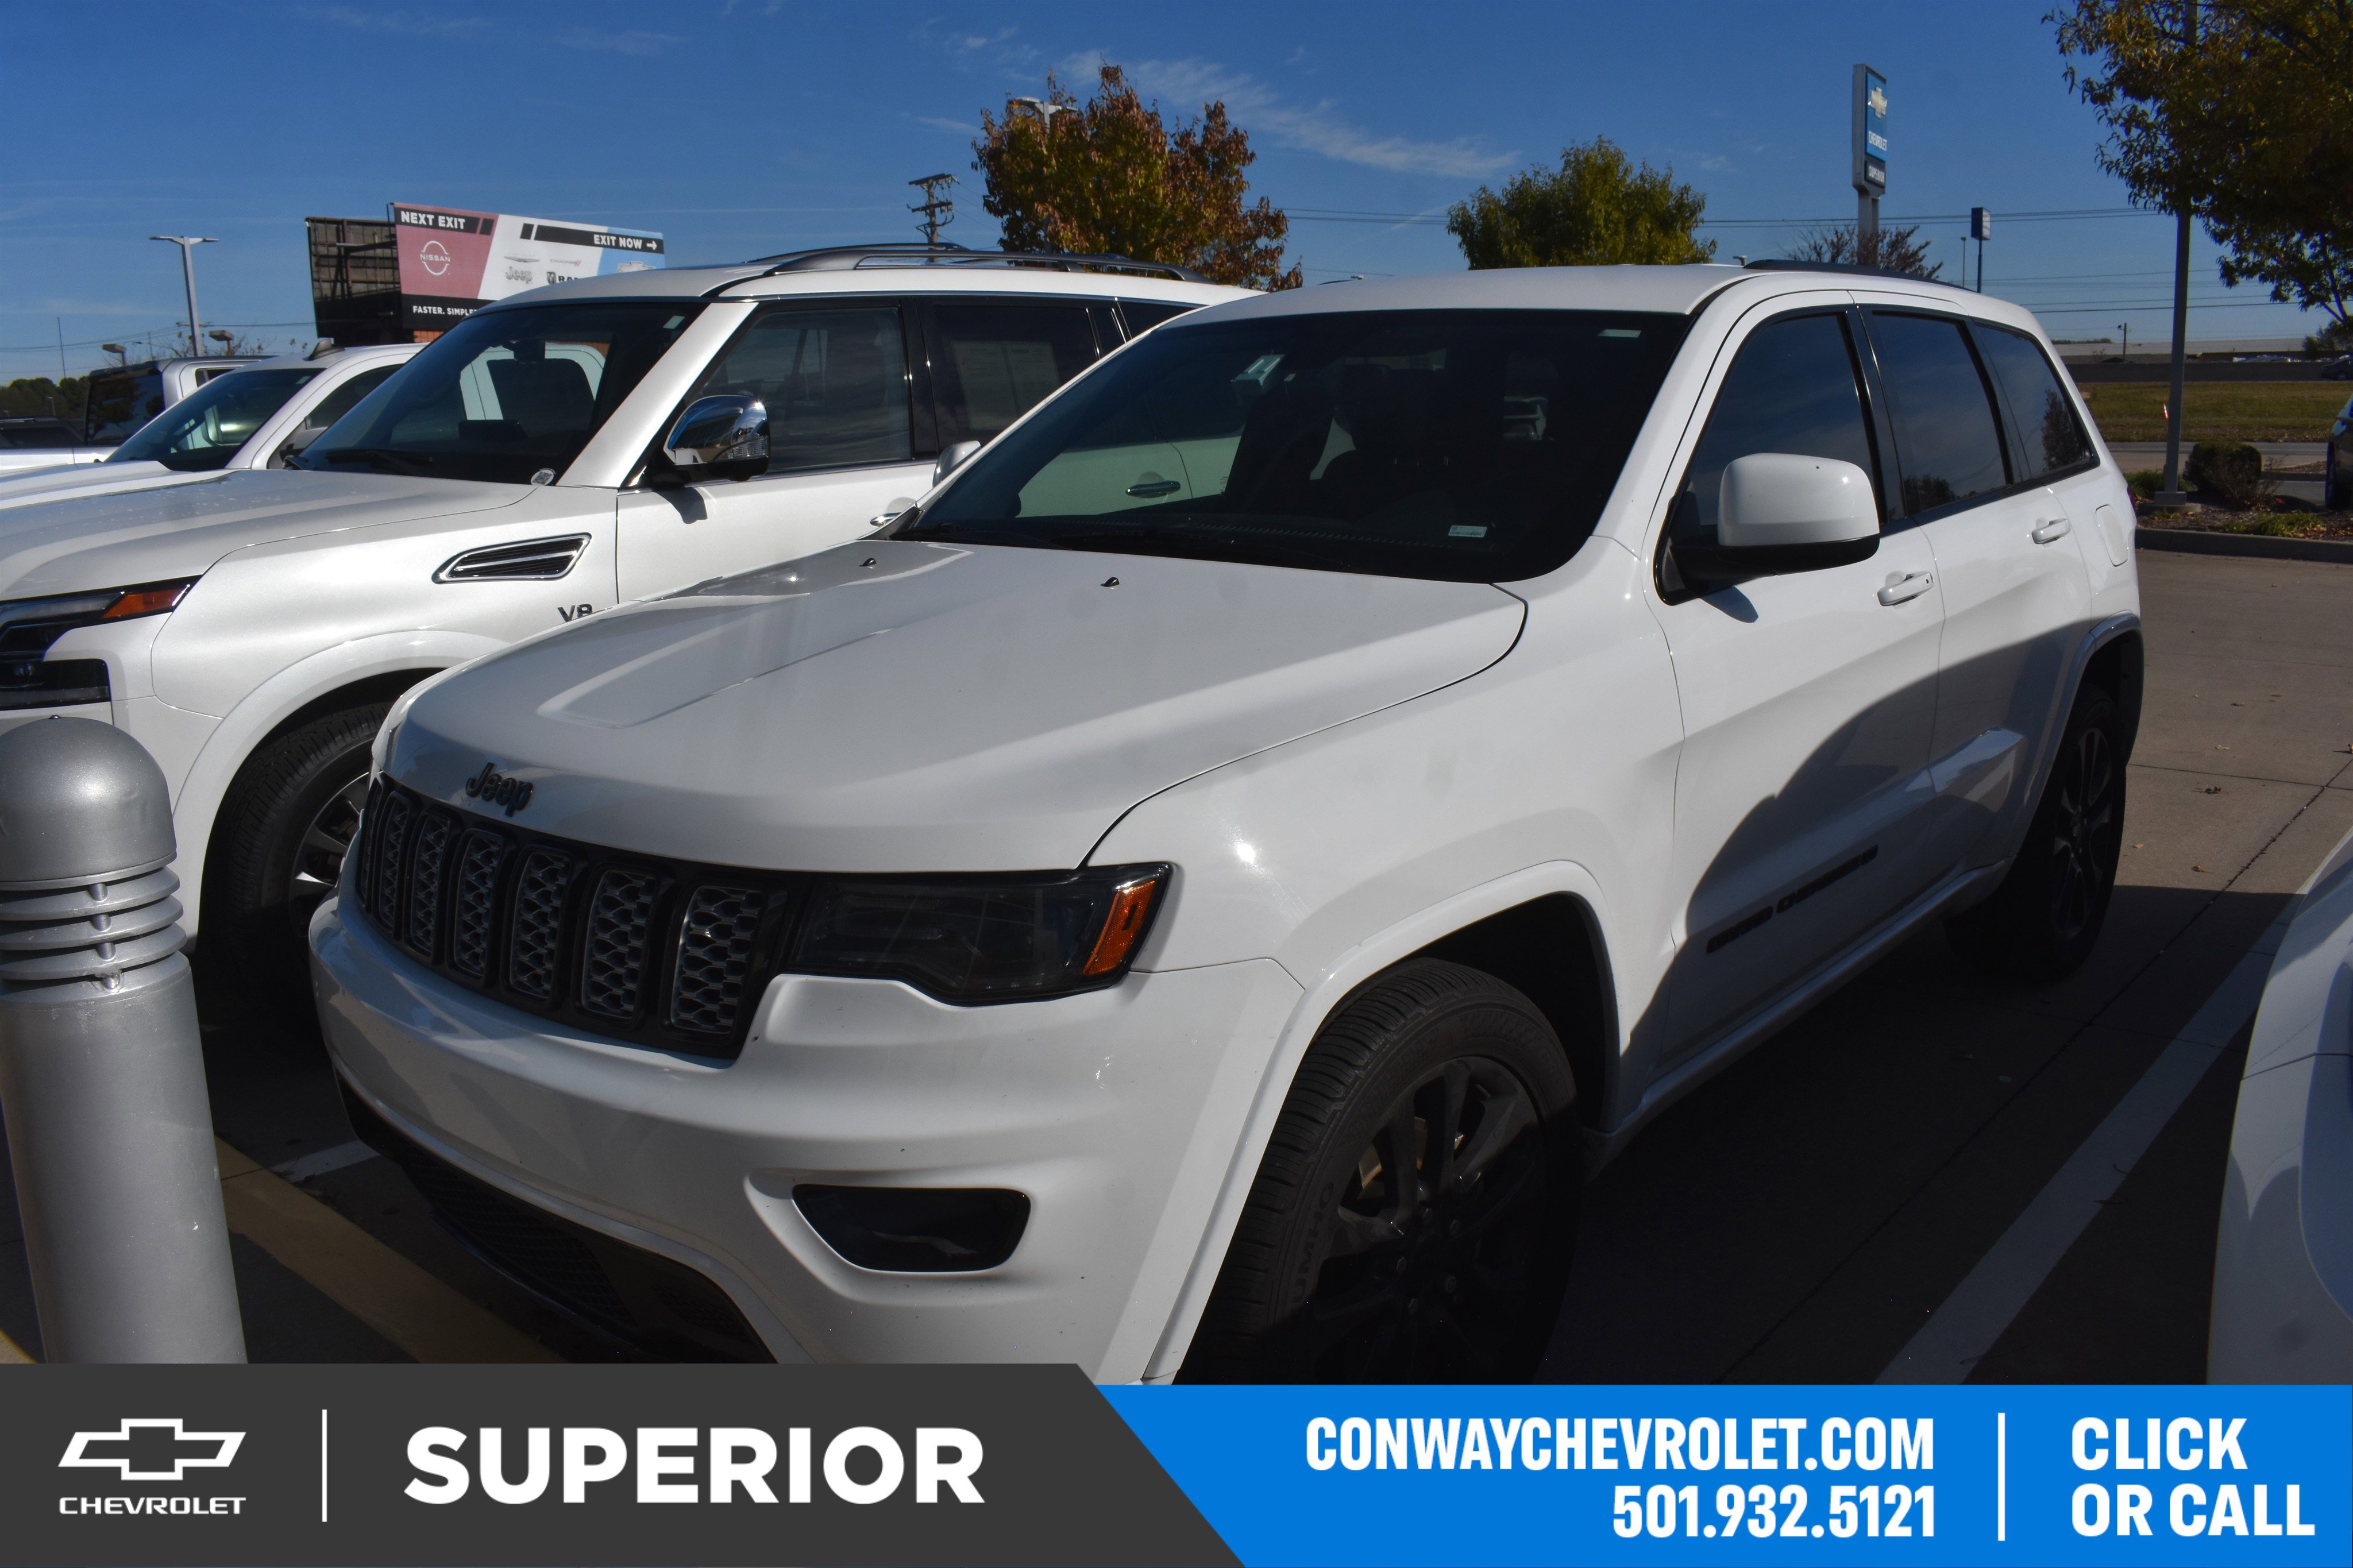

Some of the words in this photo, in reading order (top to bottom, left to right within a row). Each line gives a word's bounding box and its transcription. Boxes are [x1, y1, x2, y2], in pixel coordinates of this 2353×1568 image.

[1869, 130, 1887, 152] CHEVROLET
[400, 211, 435, 226] NEXT
[438, 215, 466, 229] EXIT
[593, 234, 616, 246] EXIT
[619, 237, 642, 249] NOW
[419, 253, 450, 262] NISSAN
[505, 266, 532, 284] Jeep
[412, 306, 445, 315] FASTER.
[447, 307, 477, 316] SIMPLE
[557, 604, 593, 623] V8
[465, 762, 534, 817] Jeep
[1291, 1181, 1334, 1307] UMHO
